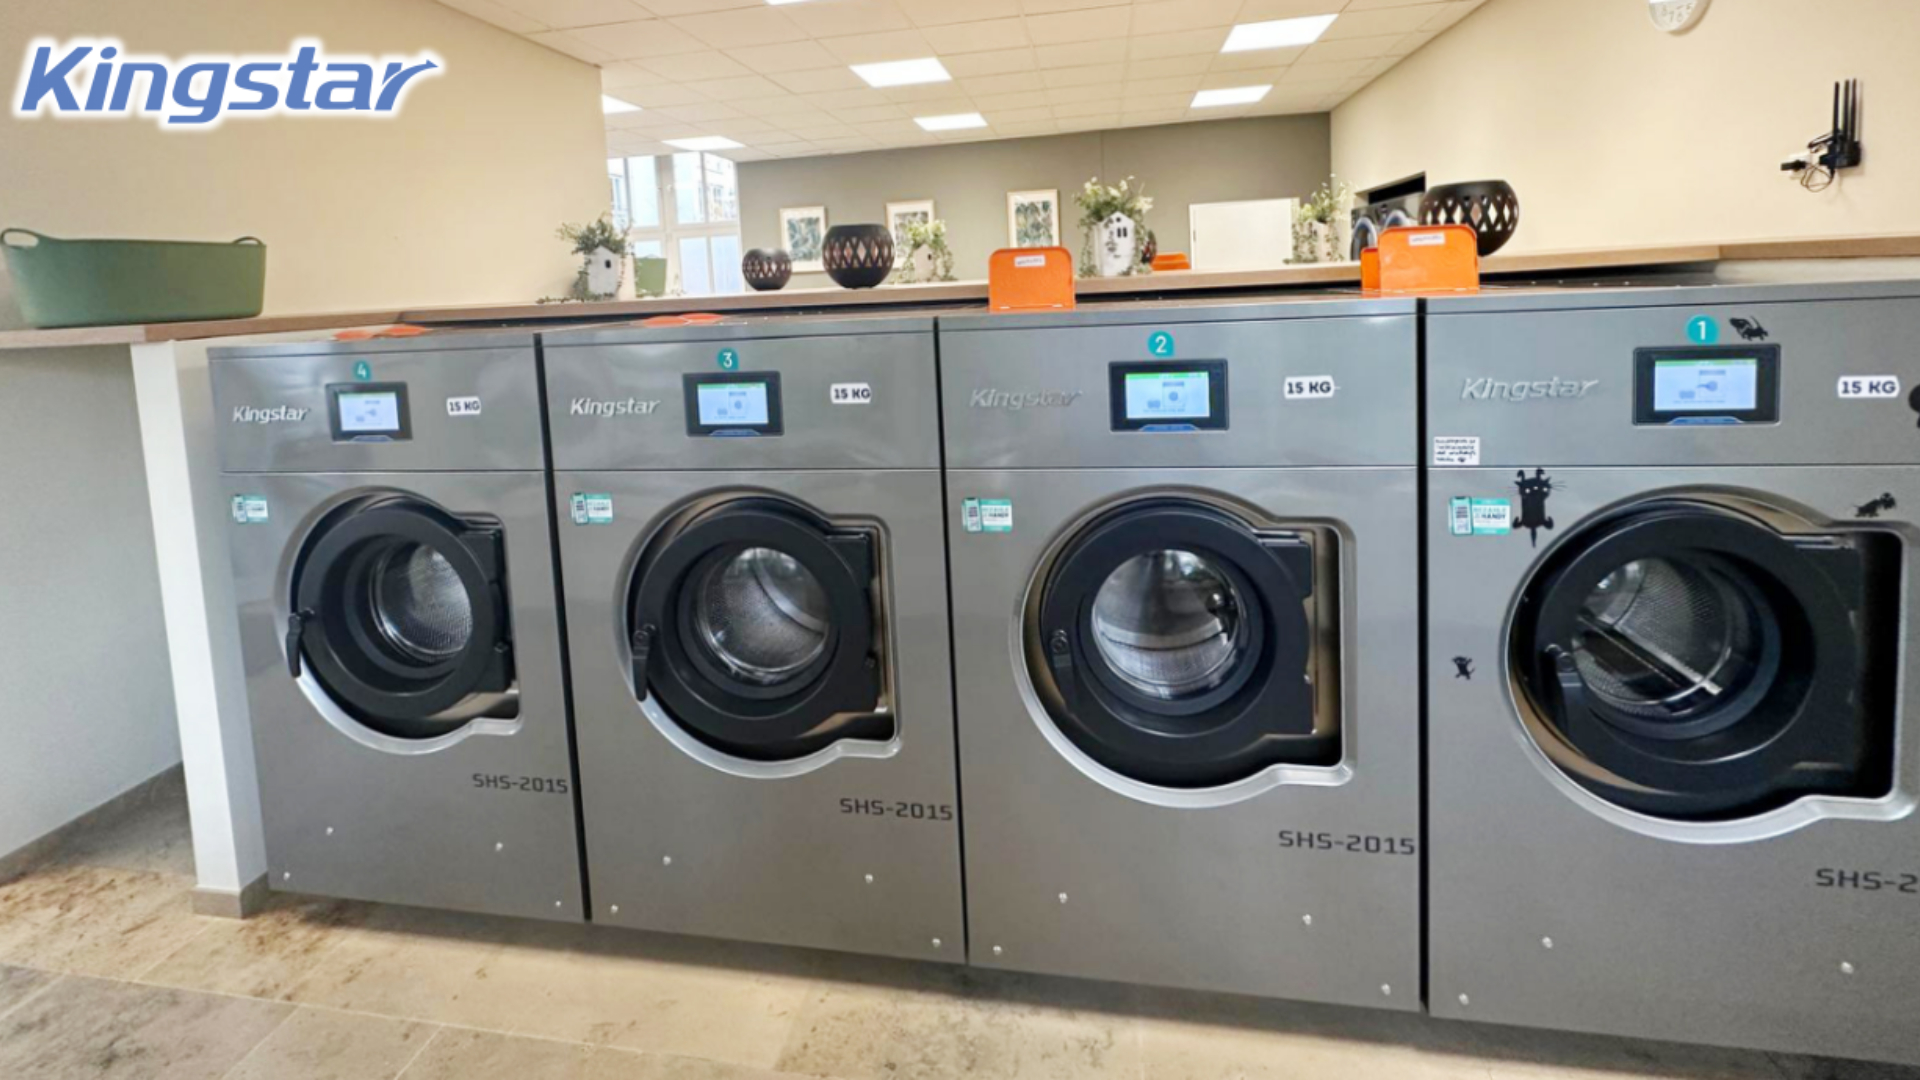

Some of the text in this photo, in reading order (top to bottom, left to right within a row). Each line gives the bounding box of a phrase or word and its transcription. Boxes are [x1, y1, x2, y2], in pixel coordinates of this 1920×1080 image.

[1697, 320, 1706, 341] 1
[1155, 336, 1167, 353] 2
[723, 352, 733, 368] 3
[357, 363, 367, 378] 4
[833, 386, 871, 401] 15 KG
[1286, 380, 1333, 395] 15 KG
[1461, 376, 1599, 402] Kingstar
[1841, 380, 1896, 395] 15 KG
[449, 400, 480, 412] 15 KG
[570, 397, 660, 417] Kingstar
[969, 387, 1080, 411] Kingstar
[232, 405, 309, 424] Kingstar
[472, 773, 568, 795] SHS-2015
[839, 797, 953, 822] SHS-2015
[1278, 830, 1416, 856] SHS-2015
[1816, 867, 1919, 893] SHS-2
